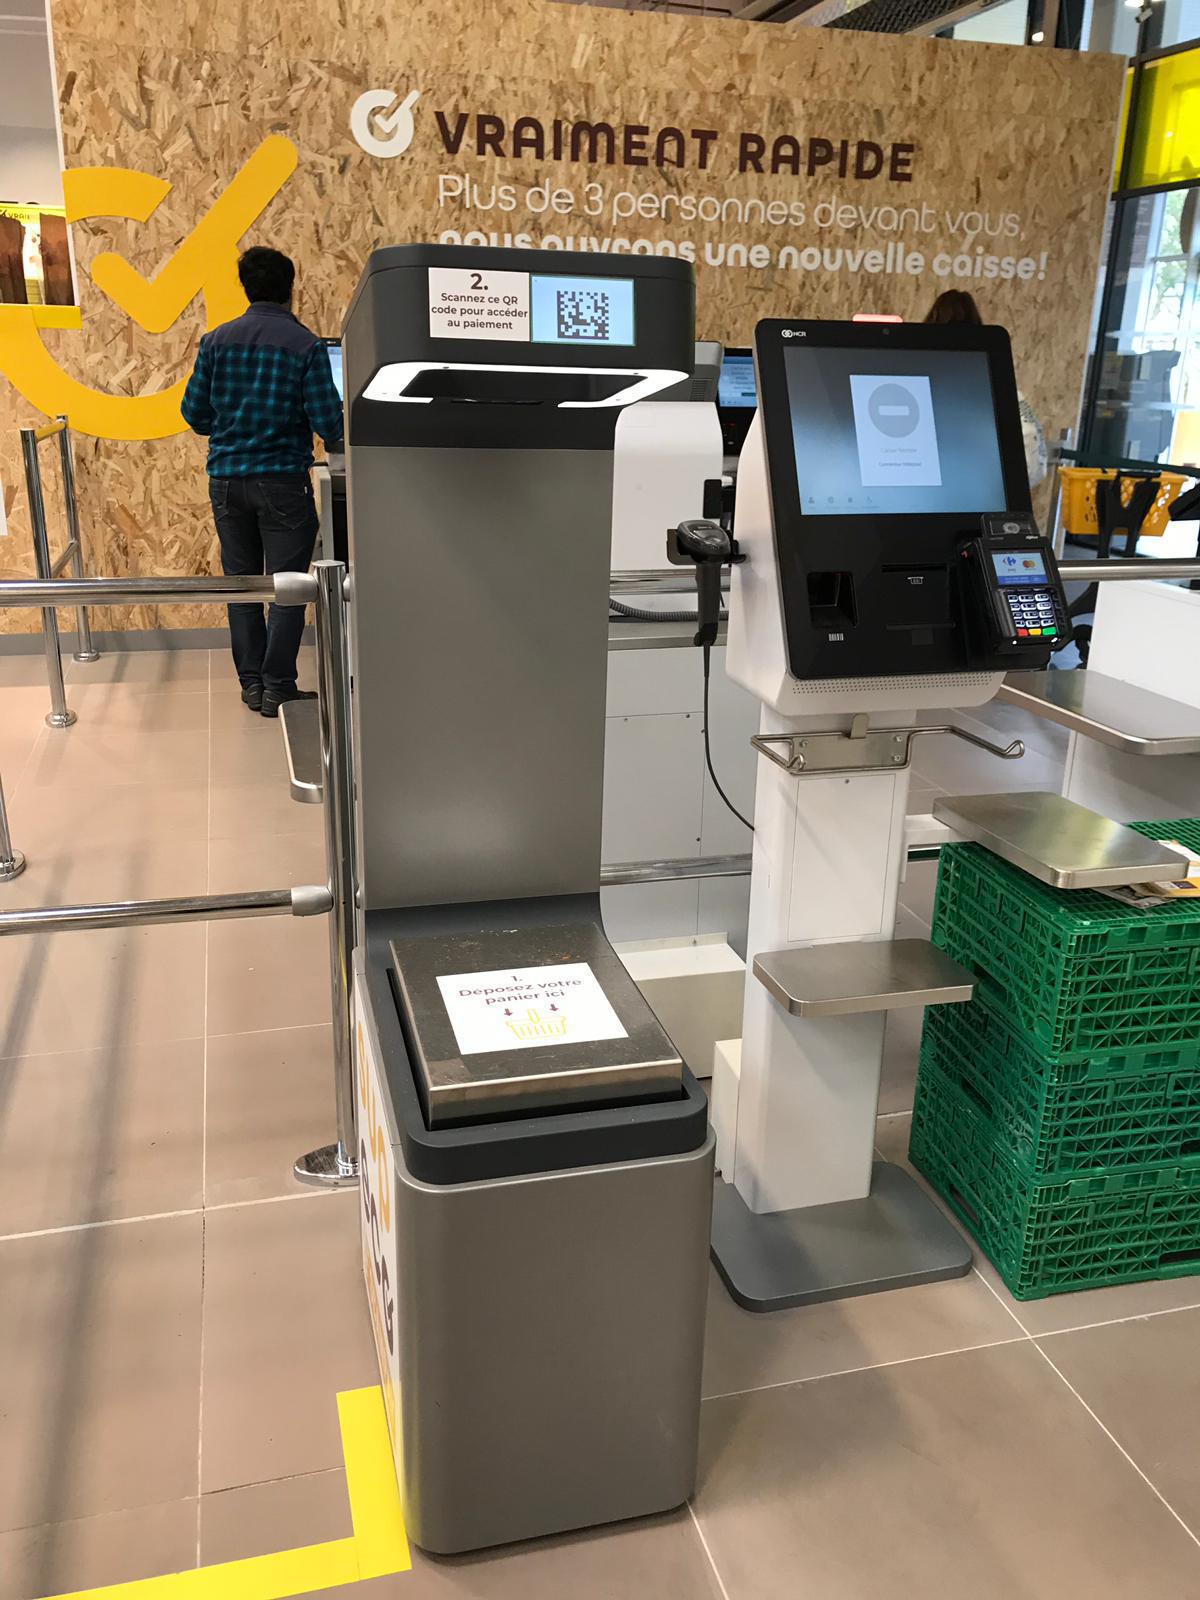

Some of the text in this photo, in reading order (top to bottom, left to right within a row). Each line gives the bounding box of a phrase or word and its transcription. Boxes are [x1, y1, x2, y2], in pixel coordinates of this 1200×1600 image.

[434, 110, 915, 183] VRAIMENT RAPIDE
[438, 173, 1026, 242] Plus de 3 personnes devant vous,
[705, 240, 771, 270] une
[778, 241, 926, 276] nouvelle
[931, 246, 1049, 281] caisse!
[469, 272, 489, 291] 2.
[441, 292, 519, 305] Scannez ce QR
[431, 305, 529, 319] code pour accéder
[447, 319, 513, 331] au paiement
[537, 978, 583, 990] votre
[485, 988, 566, 1006] panier ici
